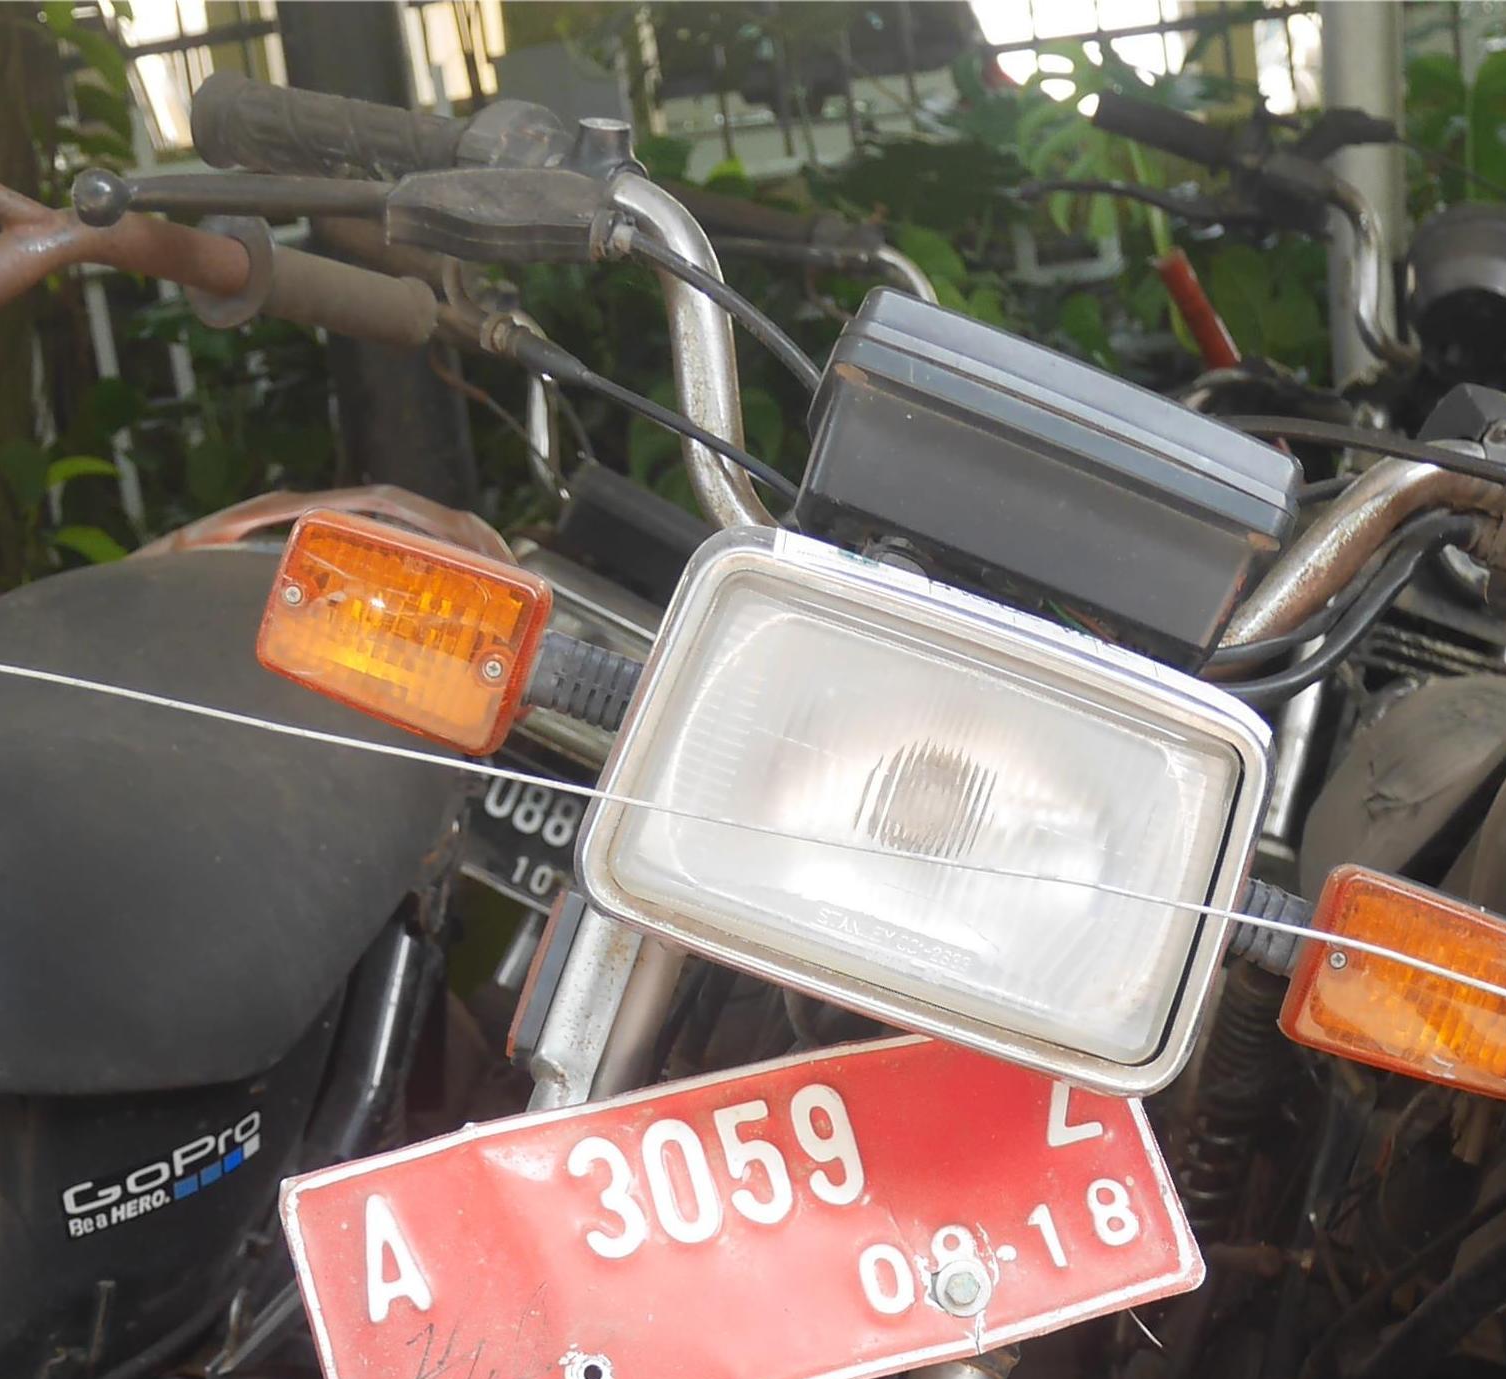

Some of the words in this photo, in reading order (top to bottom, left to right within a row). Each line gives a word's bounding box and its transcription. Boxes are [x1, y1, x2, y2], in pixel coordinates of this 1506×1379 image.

[62, 1110, 261, 1215] GoPro
[68, 1217, 95, 1238] Be
[96, 1214, 108, 1230] a
[110, 1188, 171, 1225] HERO.
[364, 1194, 434, 1323] A
[566, 1083, 866, 1258] 3059
